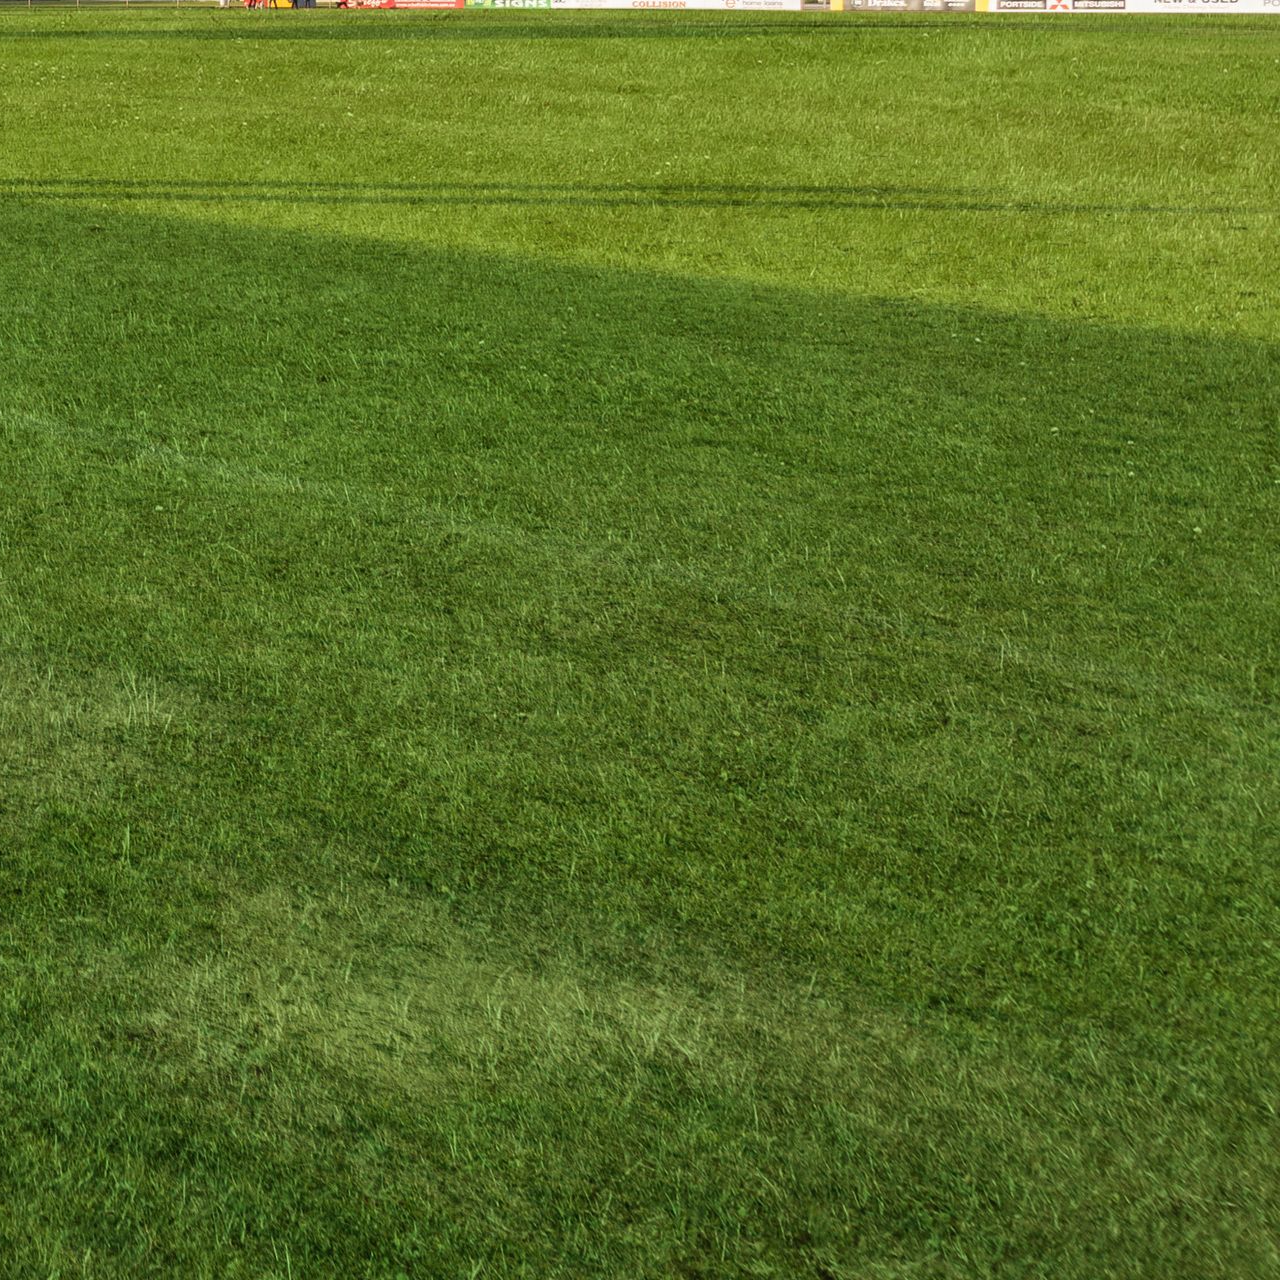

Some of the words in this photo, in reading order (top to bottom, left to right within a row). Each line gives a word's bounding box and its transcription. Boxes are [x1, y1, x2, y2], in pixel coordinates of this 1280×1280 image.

[494, 0, 549, 8] SIGNS
[999, 0, 1043, 8] PORTSIDE
[1074, 0, 1124, 8] MITSUBISHI
